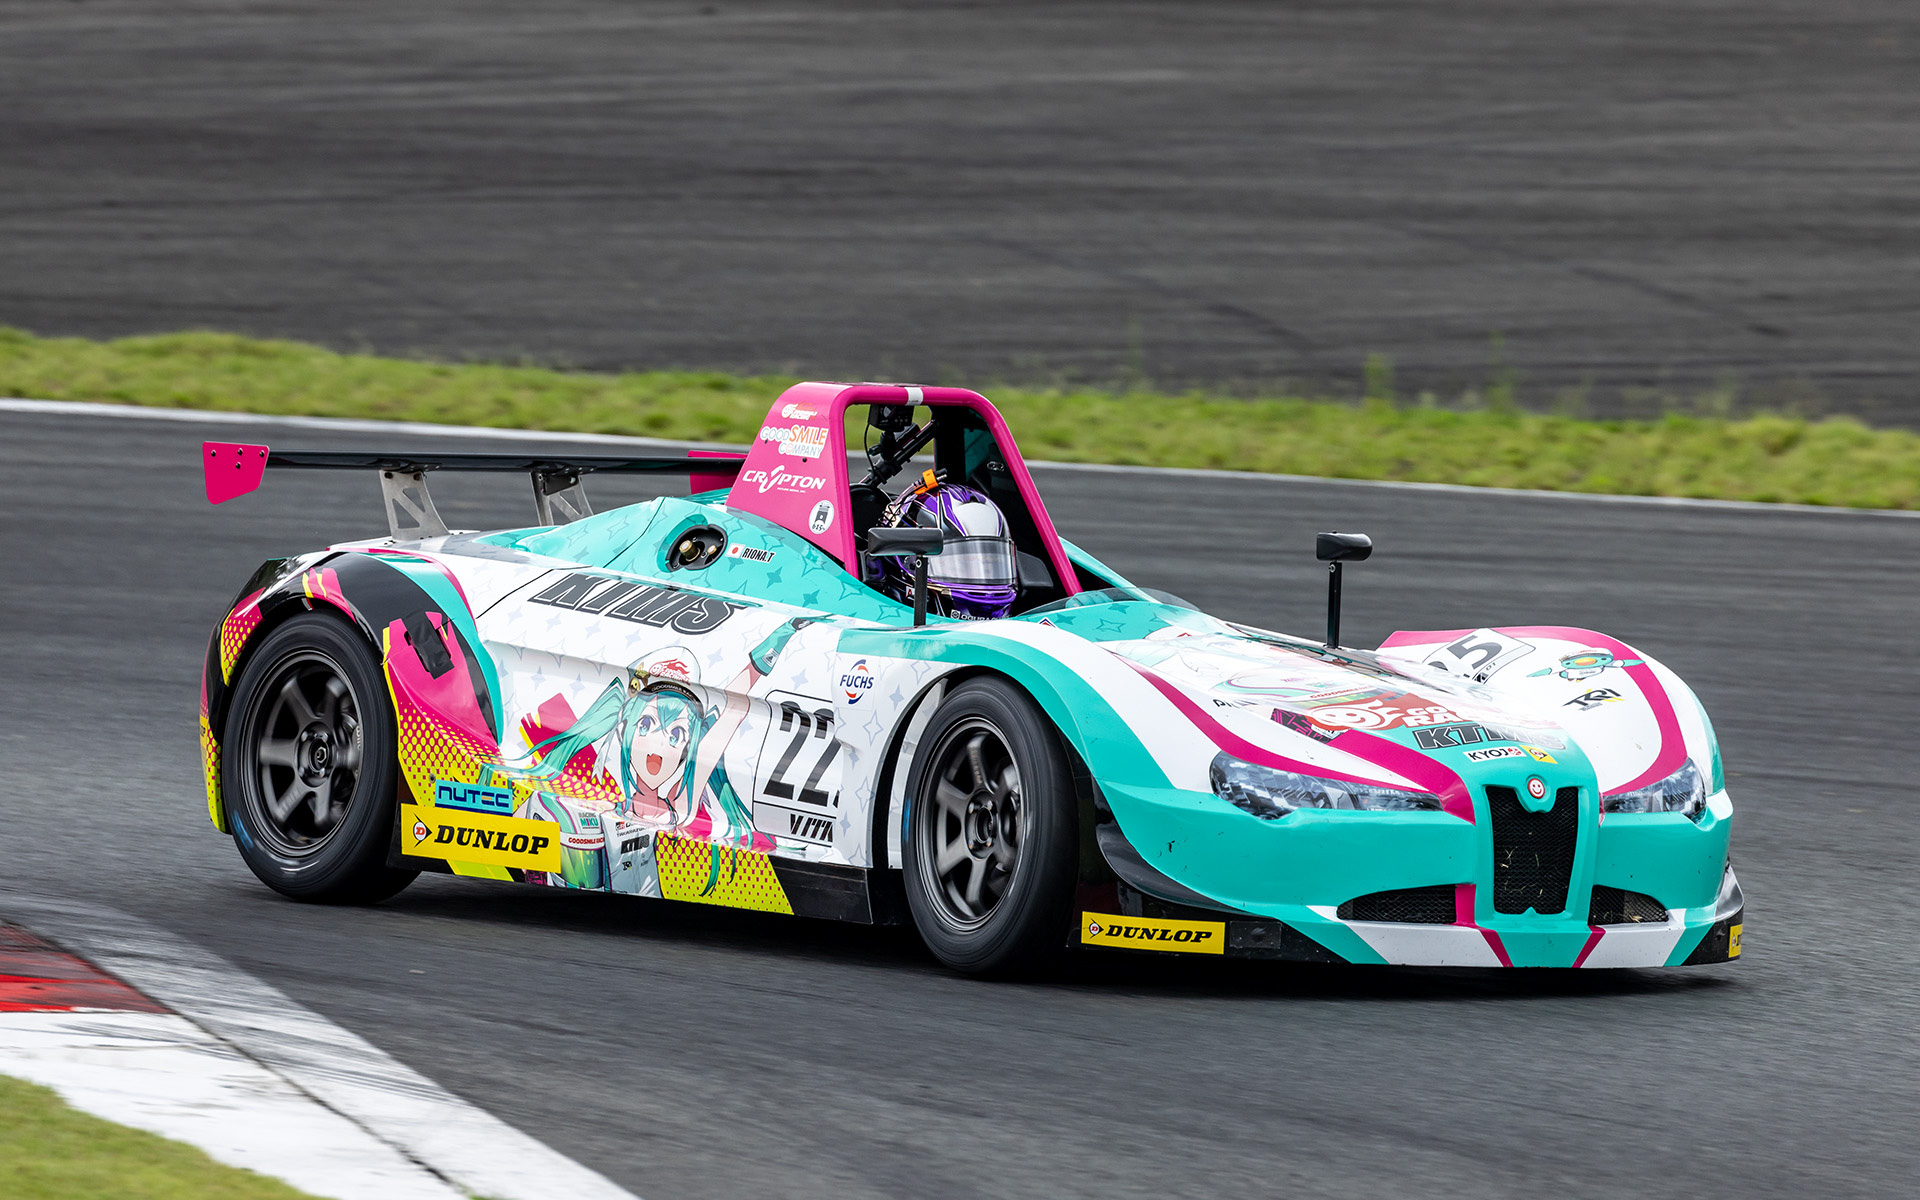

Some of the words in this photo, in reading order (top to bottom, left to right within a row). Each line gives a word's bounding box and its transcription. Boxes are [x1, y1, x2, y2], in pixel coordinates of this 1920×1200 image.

[779, 442, 823, 457] COMPANY
[742, 465, 827, 494] CRYPTON
[742, 547, 775, 562] RIONA.T
[839, 674, 874, 690] FUCHS
[580, 818, 599, 826] MIKU
[434, 824, 549, 855] DUNLOP
[1105, 924, 1213, 943] DUNLOP
